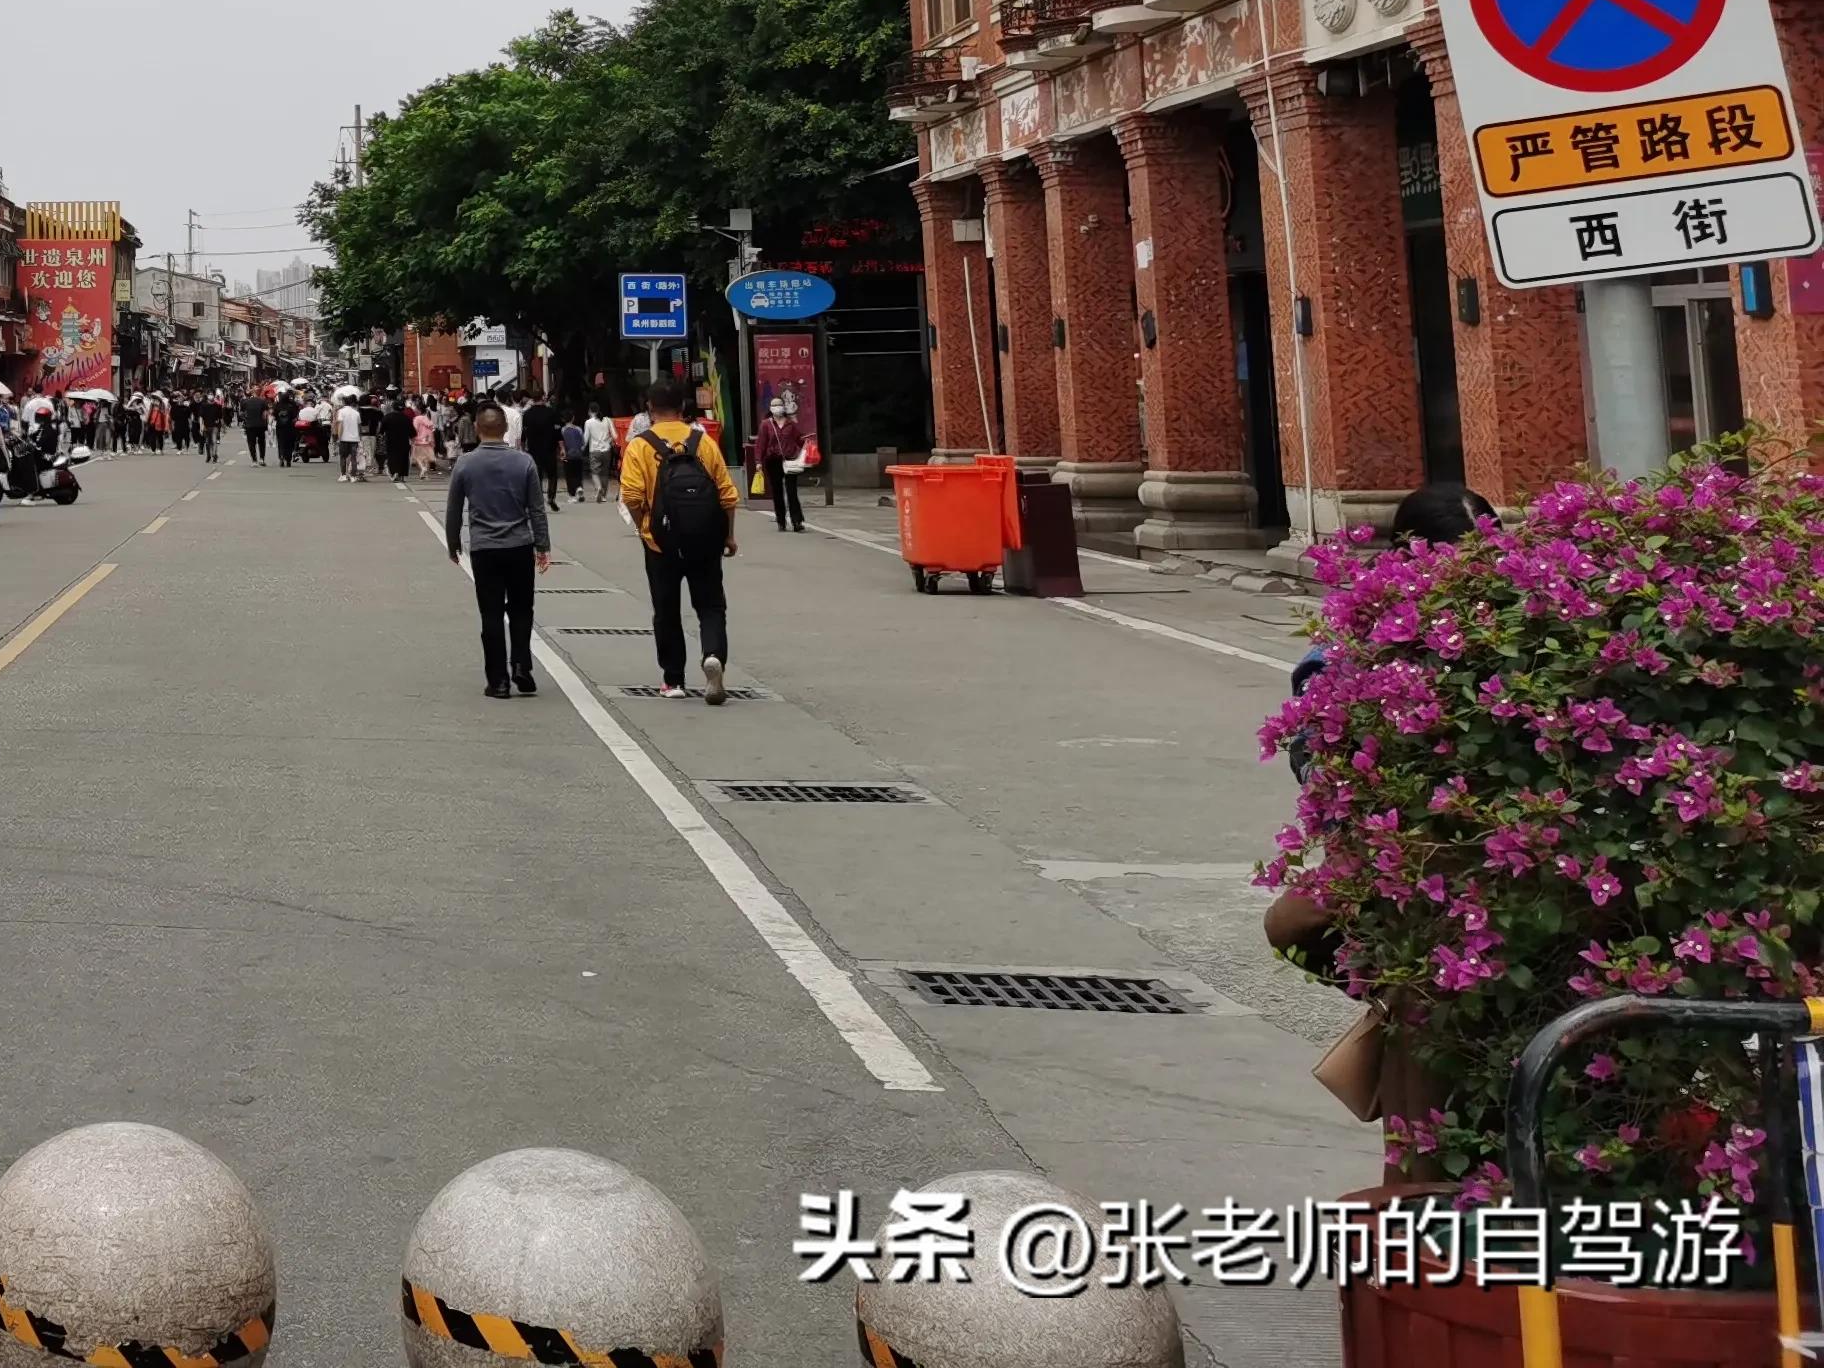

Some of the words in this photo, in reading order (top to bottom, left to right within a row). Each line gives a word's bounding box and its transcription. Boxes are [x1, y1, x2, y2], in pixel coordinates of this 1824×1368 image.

[1504, 103, 1763, 182] 严管路段
[1569, 197, 1728, 262] 西街
[20, 247, 107, 268] 世遗泉州
[31, 269, 97, 289] 欢迎您
